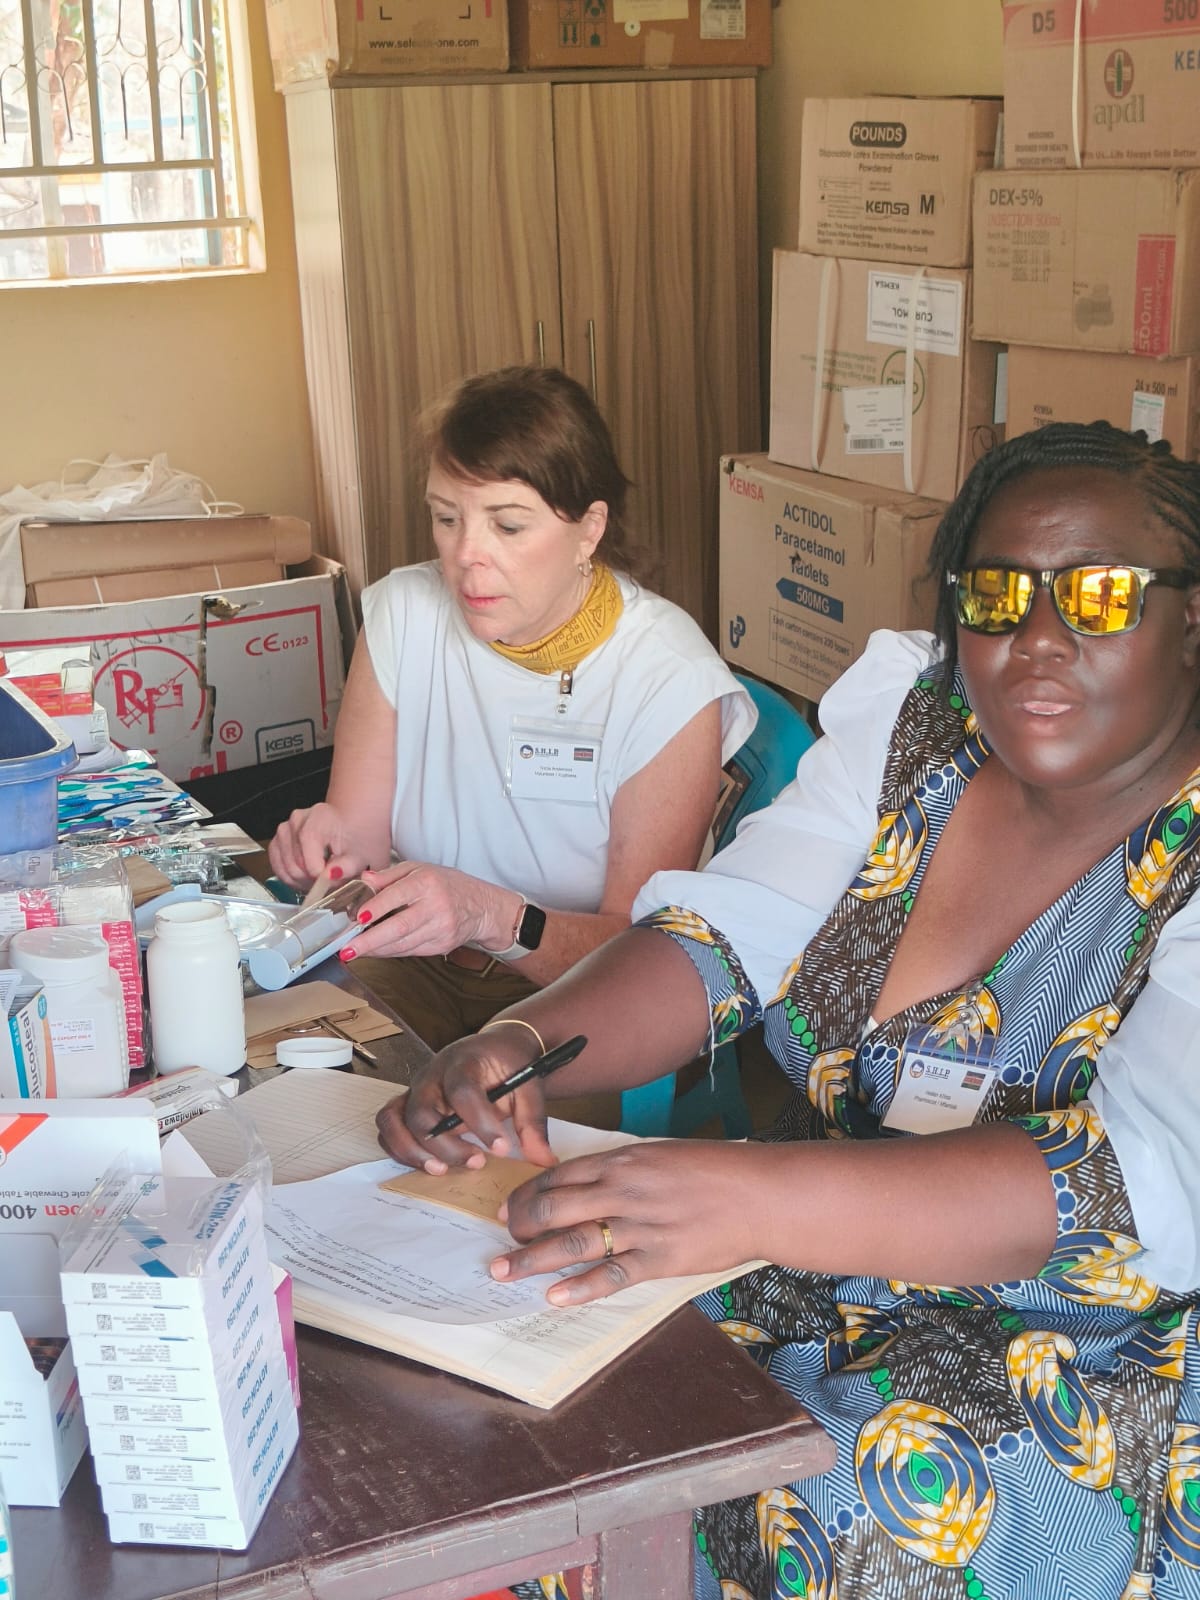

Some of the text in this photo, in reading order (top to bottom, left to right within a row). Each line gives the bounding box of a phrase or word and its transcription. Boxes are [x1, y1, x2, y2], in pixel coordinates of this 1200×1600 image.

[1032, 10, 1056, 34] D5
[1174, 50, 1200, 72] KE
[1094, 94, 1145, 131] apdl
[851, 126, 903, 143] POUNDS
[872, 151, 913, 160] Examination
[914, 152, 939, 161] Gloves
[858, 163, 892, 173] Powdered
[920, 194, 935, 215] M
[989, 188, 1043, 207] DEX-5%
[892, 306, 933, 322] CURMOL
[1152, 381, 1165, 395] 500
[1167, 384, 1178, 397] ml
[728, 472, 765, 503] KEMSA
[783, 502, 837, 536] ACTIDOL
[775, 524, 846, 567] Paracetamol
[789, 555, 830, 588] Tablets
[796, 586, 830, 614] 500MG
[282, 636, 310, 651] 0123
[265, 734, 304, 753] KEBS
[25, 1190, 69, 1198] Chewable
